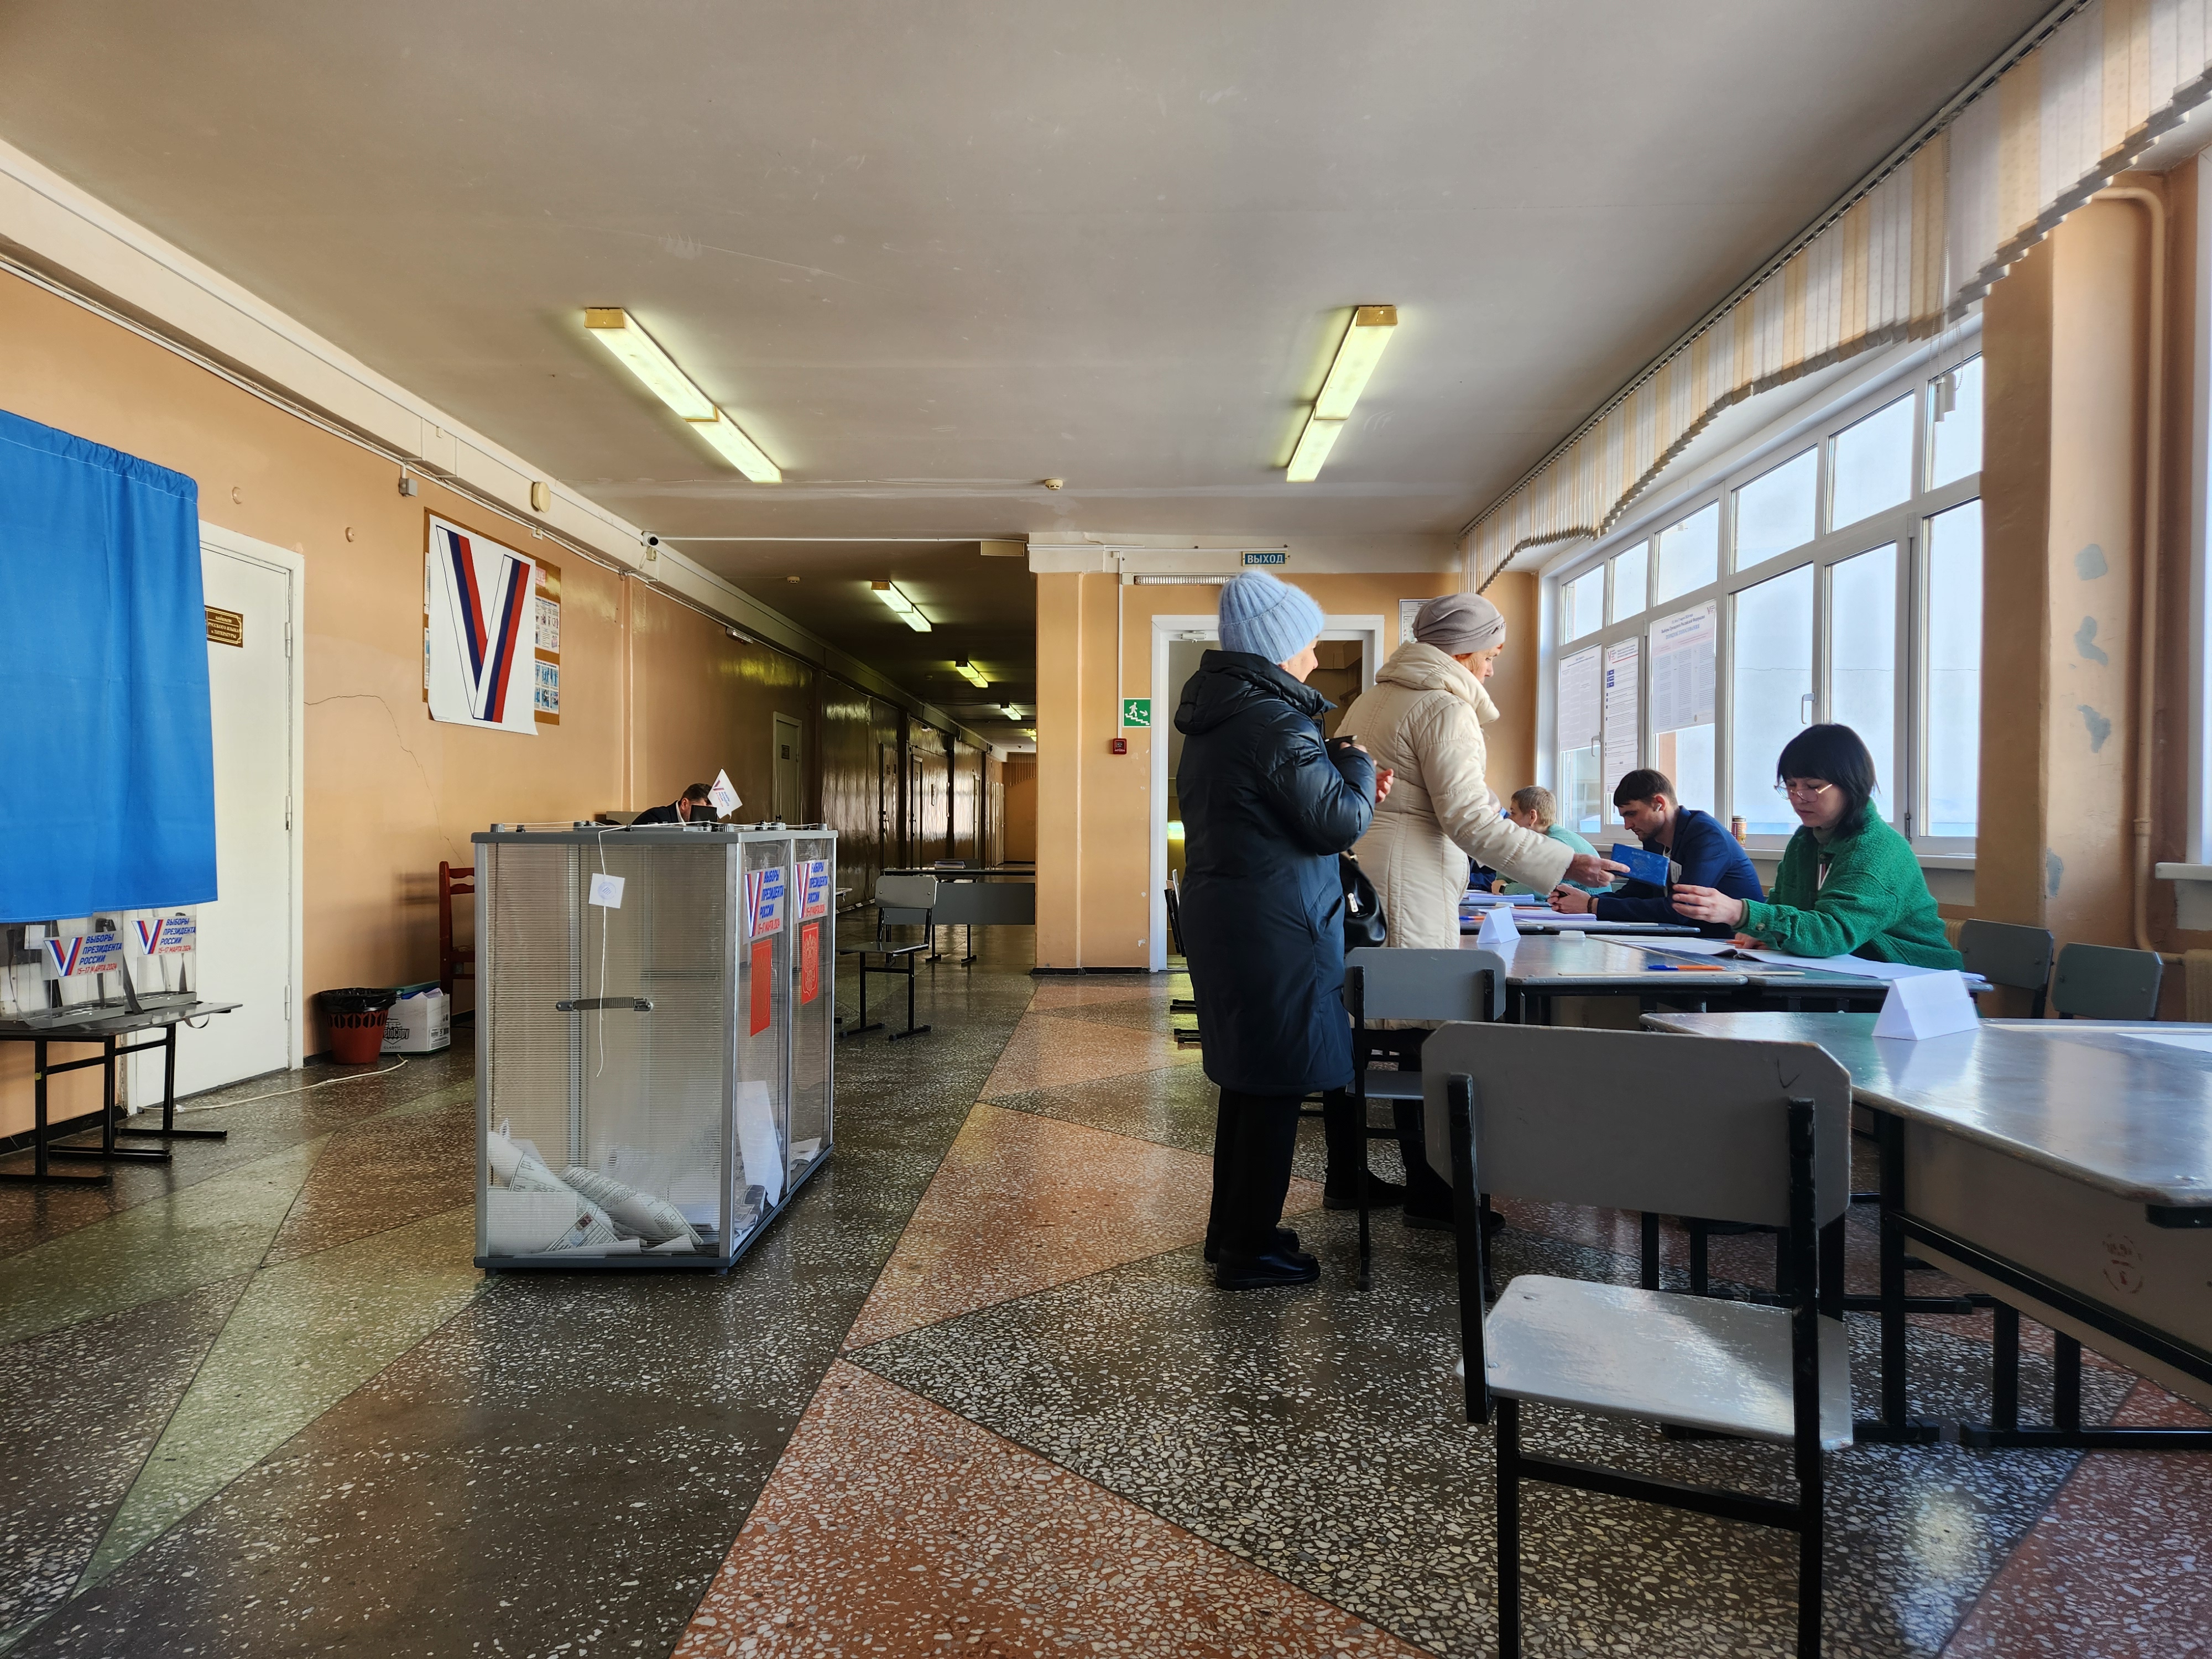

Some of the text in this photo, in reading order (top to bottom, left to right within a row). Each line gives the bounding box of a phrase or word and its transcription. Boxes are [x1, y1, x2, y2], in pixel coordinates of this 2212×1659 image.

[1247, 554, 1284, 564] ВЫХОД
[764, 869, 780, 883] ВЫБОРЫ
[809, 876, 828, 888] ПРЕЗИДЕНТА
[761, 885, 784, 901] ПРЕЗИДЕНТА
[807, 891, 820, 904] РОССИИ
[759, 904, 774, 919] РОССИИ
[163, 926, 196, 936] ПРЕЗИДЕНТА
[85, 933, 114, 944] ВЫБОРЫ
[160, 937, 182, 945] РОССИИ
[82, 943, 122, 954] ПРЕЗИДЕНТА
[79, 954, 106, 965] РОССИИ
[383, 1027, 410, 1040] etoCopy
